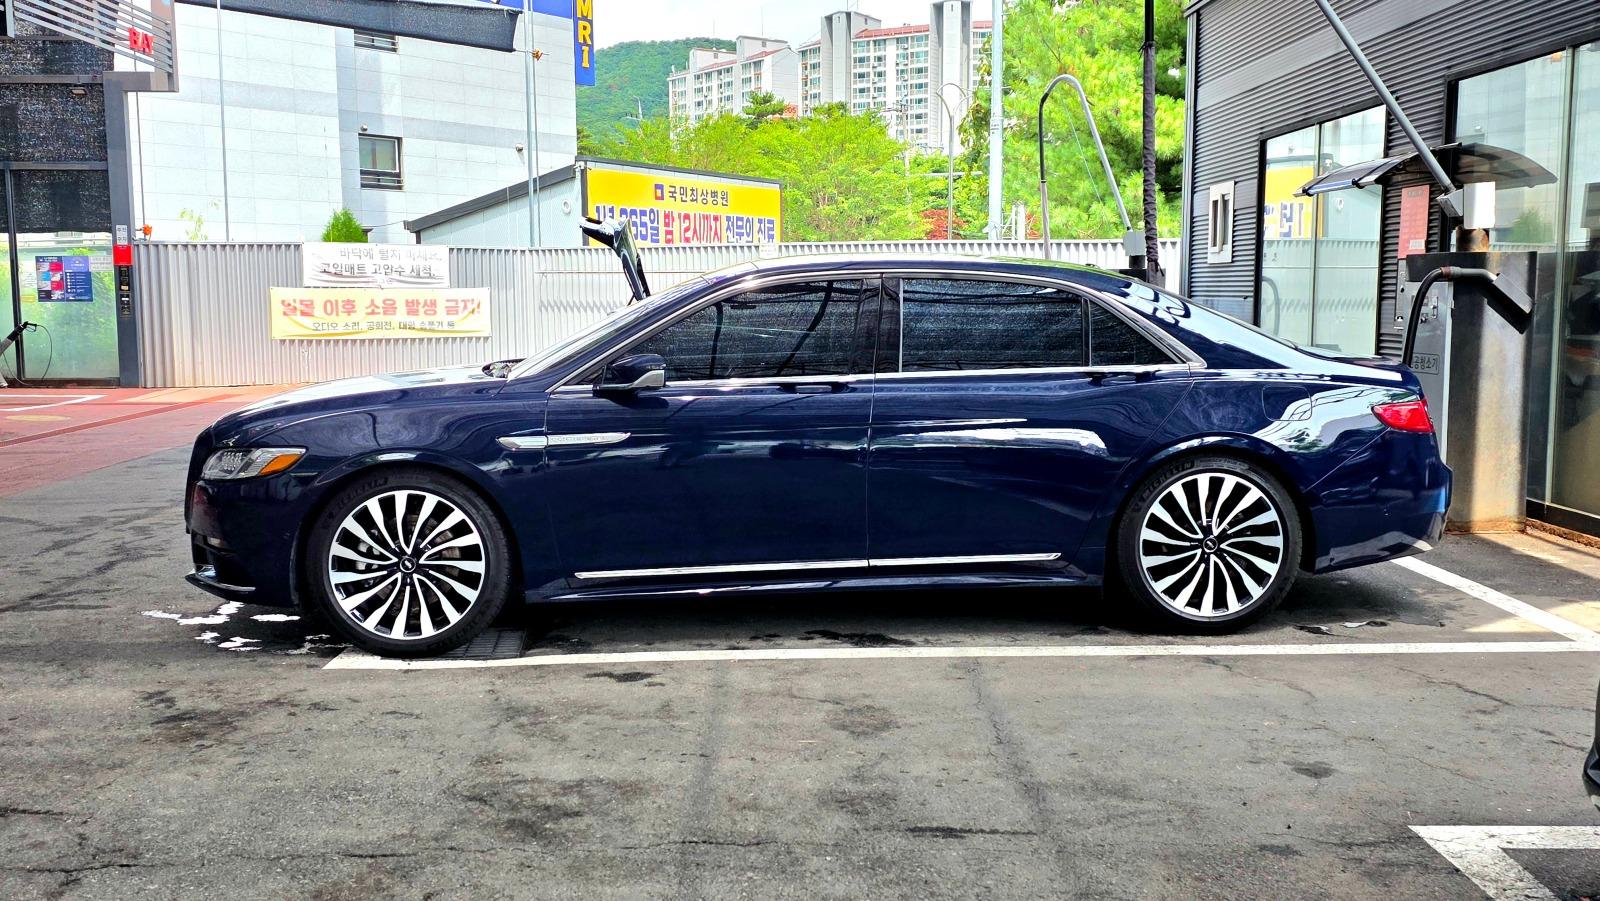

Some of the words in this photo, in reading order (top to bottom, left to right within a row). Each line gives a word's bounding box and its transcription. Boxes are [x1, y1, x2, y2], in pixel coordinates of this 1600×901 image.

[576, 0, 592, 68] MRI
[668, 185, 729, 207] 국민최상병원
[664, 210, 675, 244] 밤
[678, 212, 722, 244] 12시까지
[340, 248, 374, 261] 바닥에
[379, 249, 401, 262] 털지
[372, 264, 406, 277] 고압수
[281, 299, 315, 317] 일몰
[323, 299, 357, 317] 이후
[365, 299, 398, 316] 소음
[405, 299, 437, 316] 발생
[312, 322, 339, 331] 오디오
[1410, 355, 1438, 371] 공청소기
